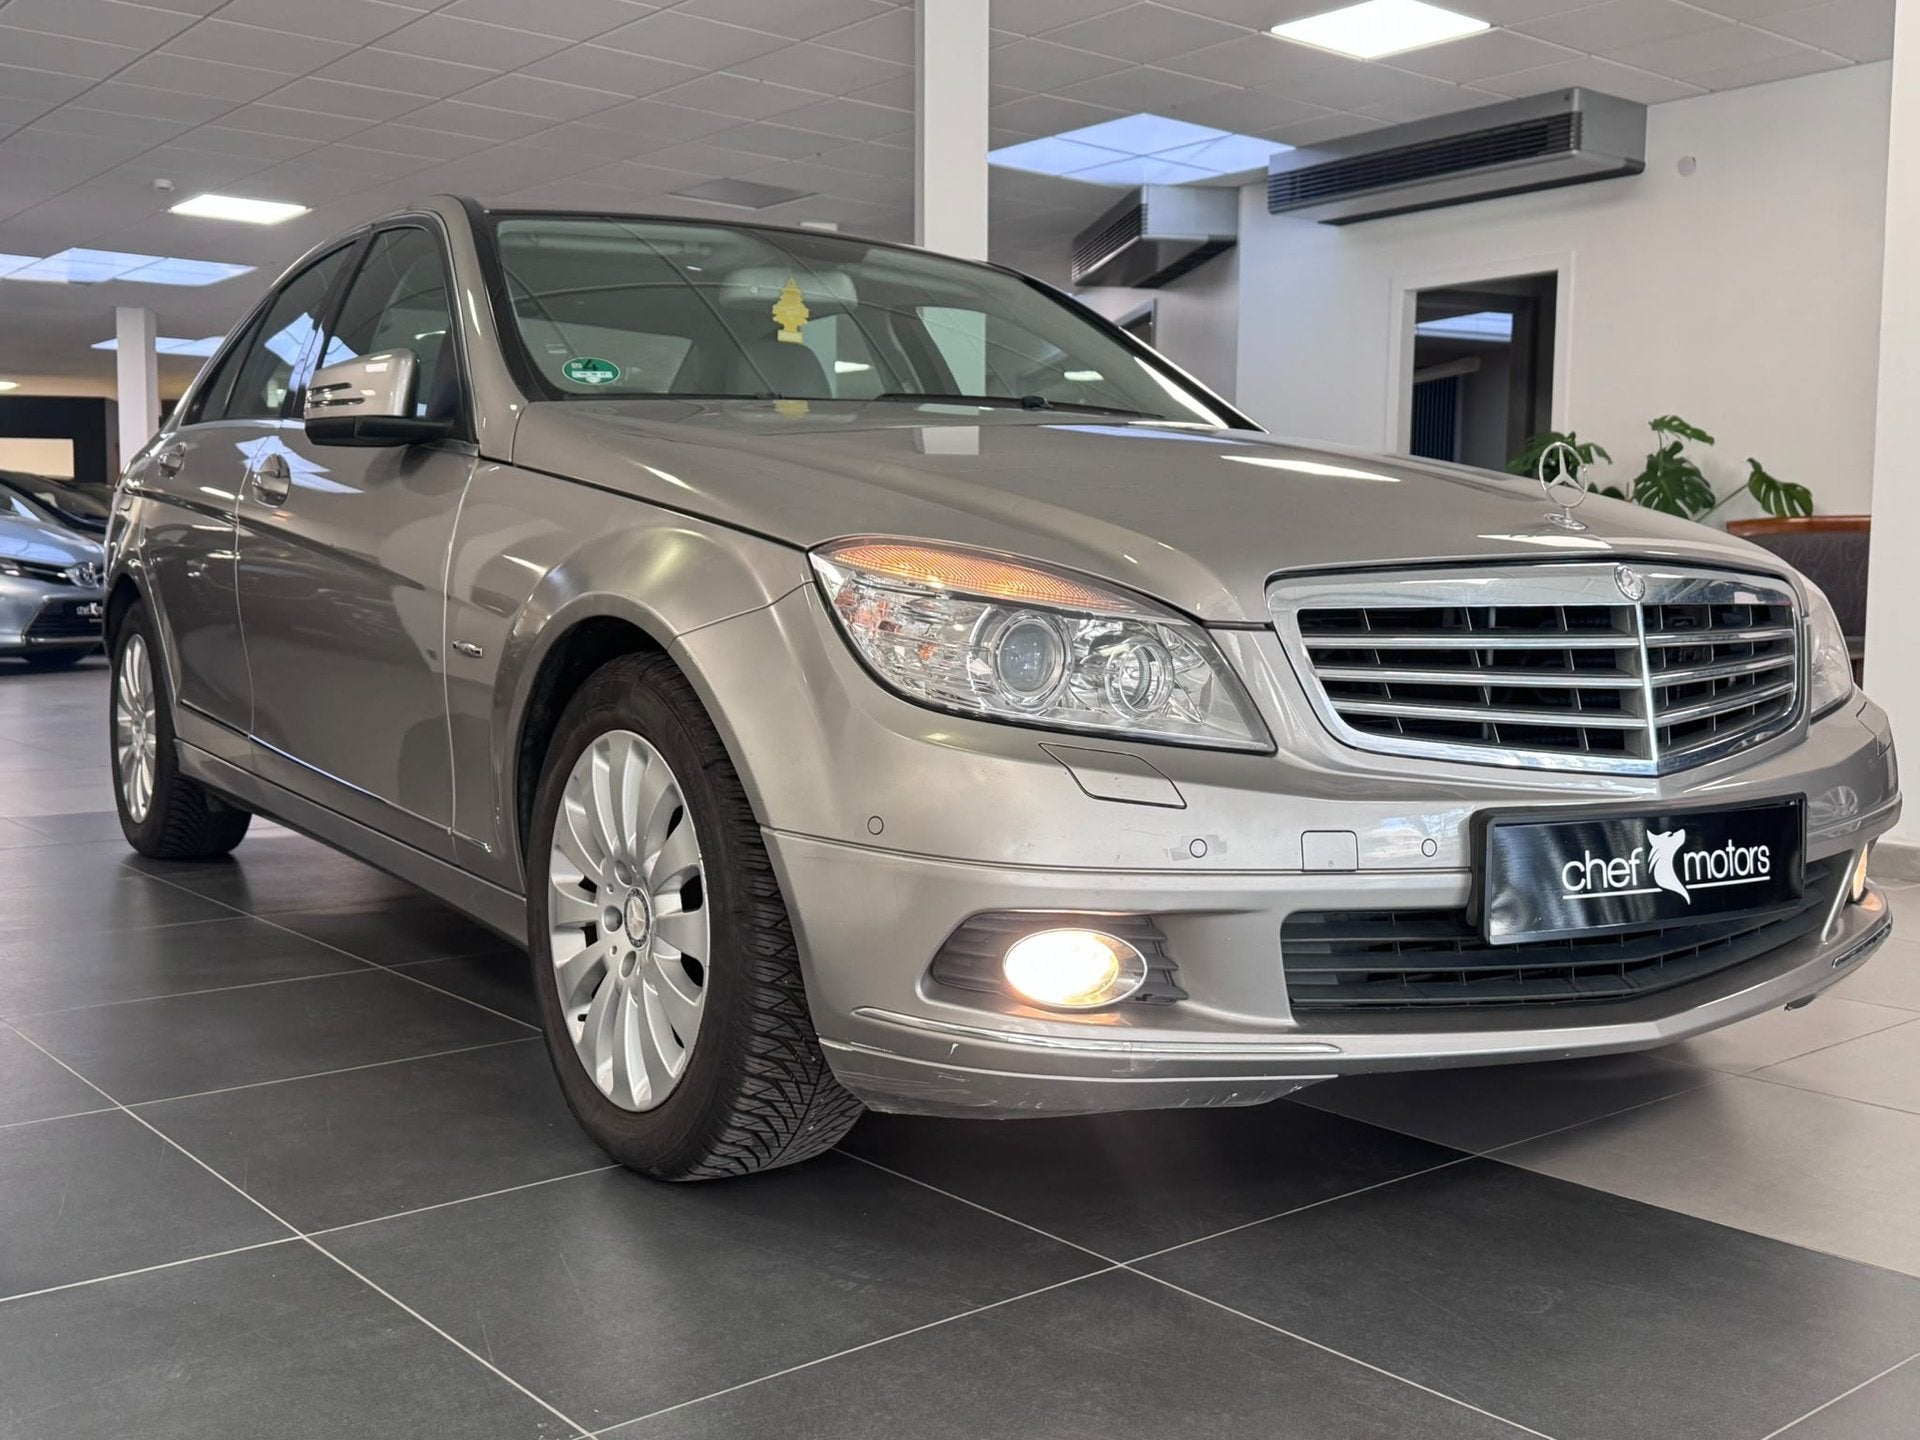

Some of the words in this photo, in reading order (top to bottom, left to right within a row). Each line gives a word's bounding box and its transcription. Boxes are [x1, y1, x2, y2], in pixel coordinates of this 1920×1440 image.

[582, 359, 599, 371] 4
[1562, 847, 1643, 891] chef
[1684, 839, 1770, 881] motors
